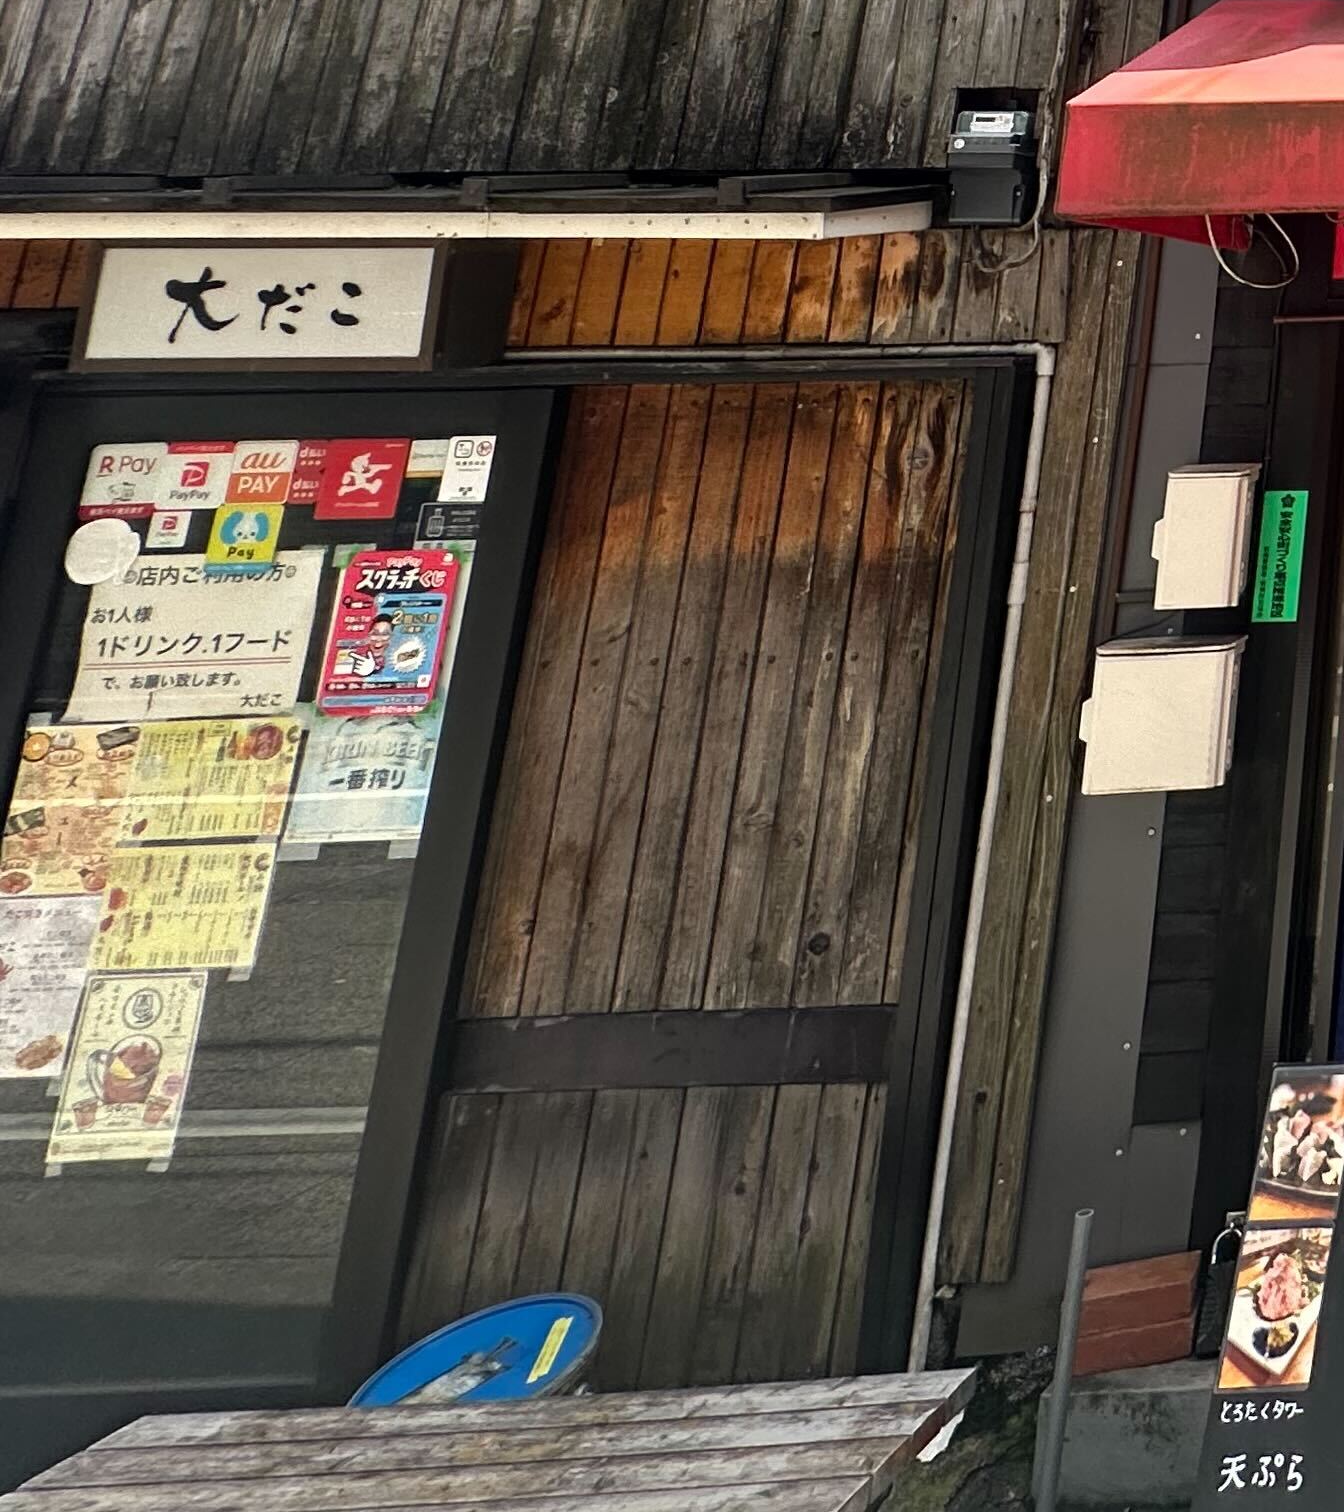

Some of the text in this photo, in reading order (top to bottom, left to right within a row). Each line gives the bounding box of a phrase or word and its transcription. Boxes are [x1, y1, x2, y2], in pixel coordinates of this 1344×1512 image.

[165, 266, 363, 344] 大だこ
[119, 456, 157, 475] Pay
[241, 452, 286, 469] au
[237, 476, 278, 494] PAY
[169, 489, 210, 501] PayPay
[227, 546, 254, 561] Pay
[91, 606, 153, 624] お1人様
[329, 769, 406, 790] 一番搾り
[1218, 1453, 1304, 1492] 天ぷら
